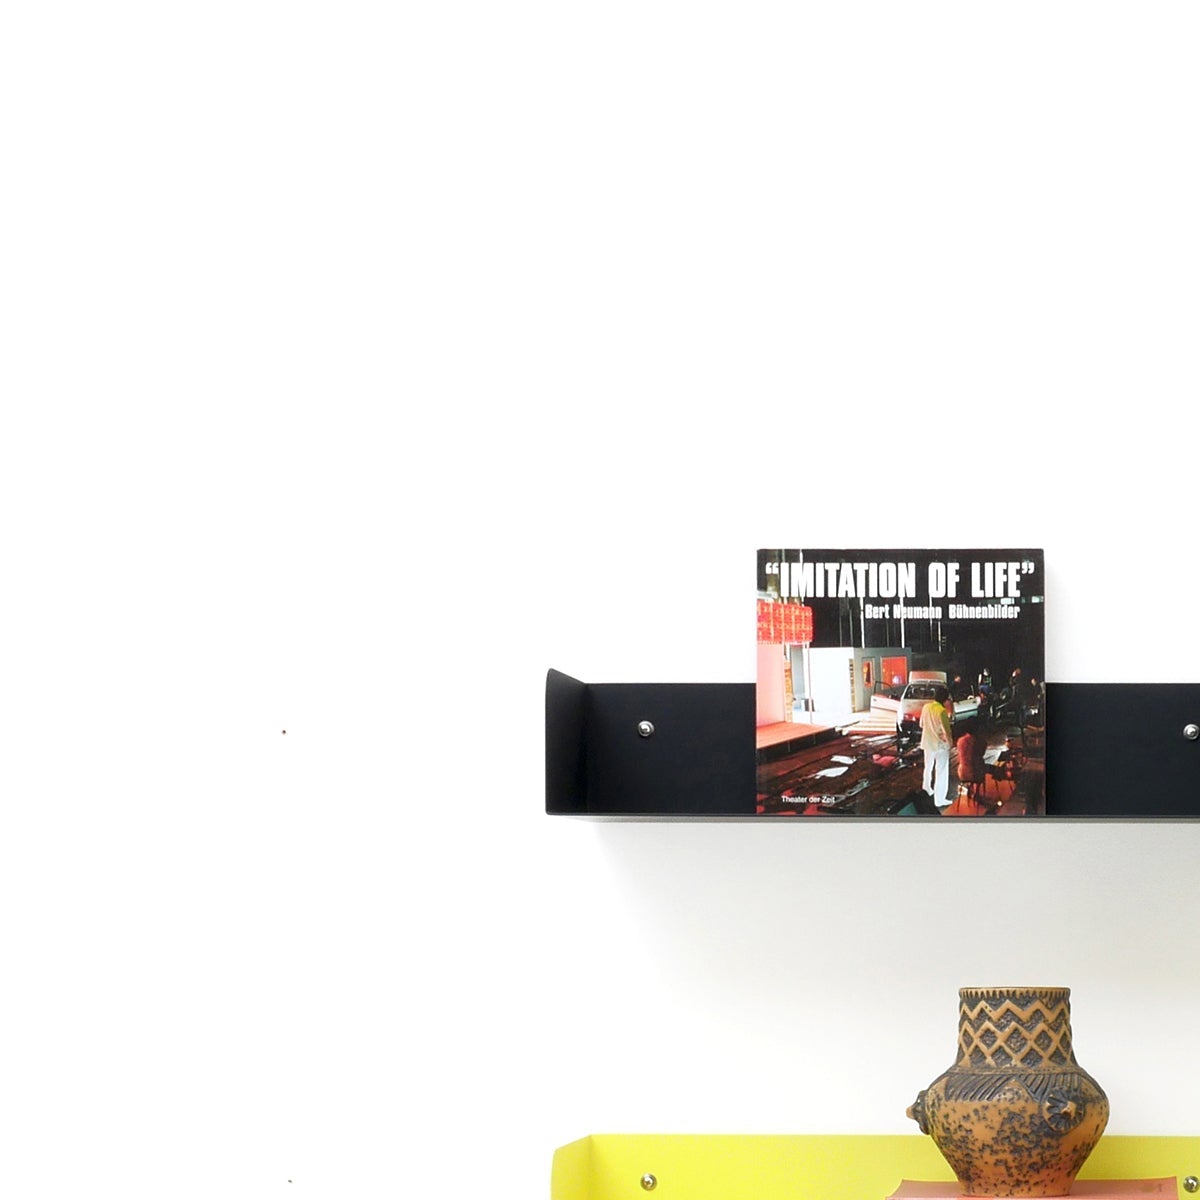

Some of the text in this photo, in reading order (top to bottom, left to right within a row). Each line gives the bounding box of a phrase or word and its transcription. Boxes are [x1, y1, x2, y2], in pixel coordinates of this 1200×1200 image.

[928, 562, 960, 598] OF
[971, 562, 1035, 598] LIFE”
[864, 604, 1020, 619] Bert Neumann Bühnenbilder
[781, 795, 836, 804] Theater der Zeit
